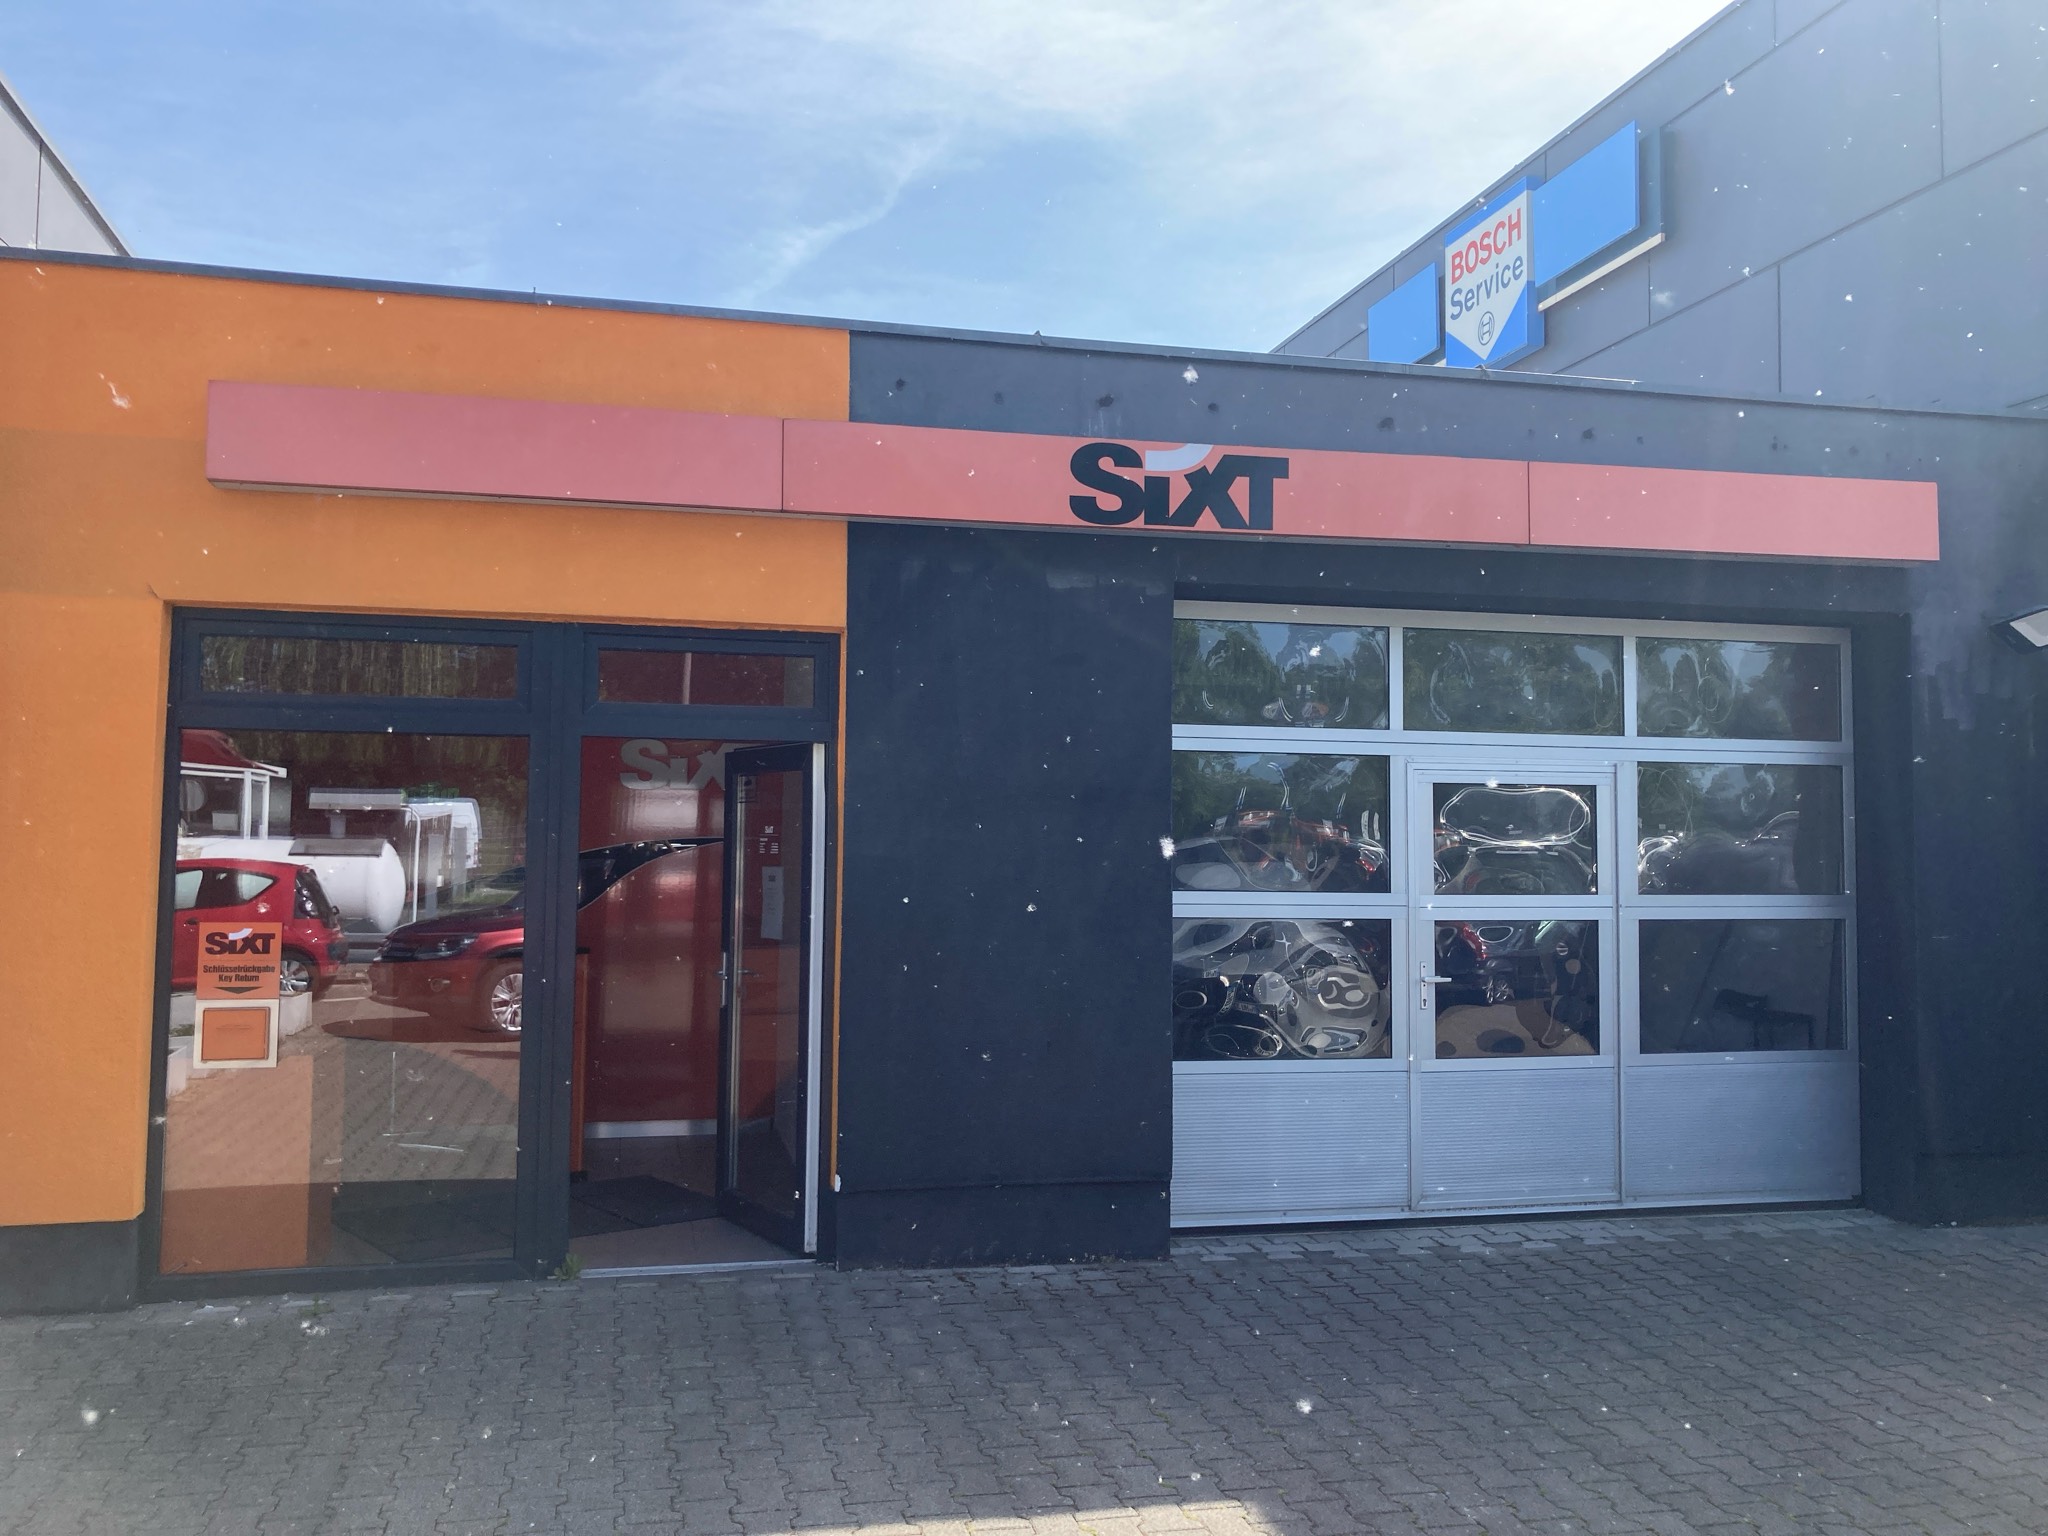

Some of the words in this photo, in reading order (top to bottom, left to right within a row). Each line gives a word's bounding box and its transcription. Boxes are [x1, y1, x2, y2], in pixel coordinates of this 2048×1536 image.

[1451, 207, 1521, 285] BOSCH
[1450, 255, 1524, 320] Service
[203, 964, 276, 974] Schlüsselrückgabe
[218, 973, 233, 983] Key
[235, 973, 260, 983] Return
